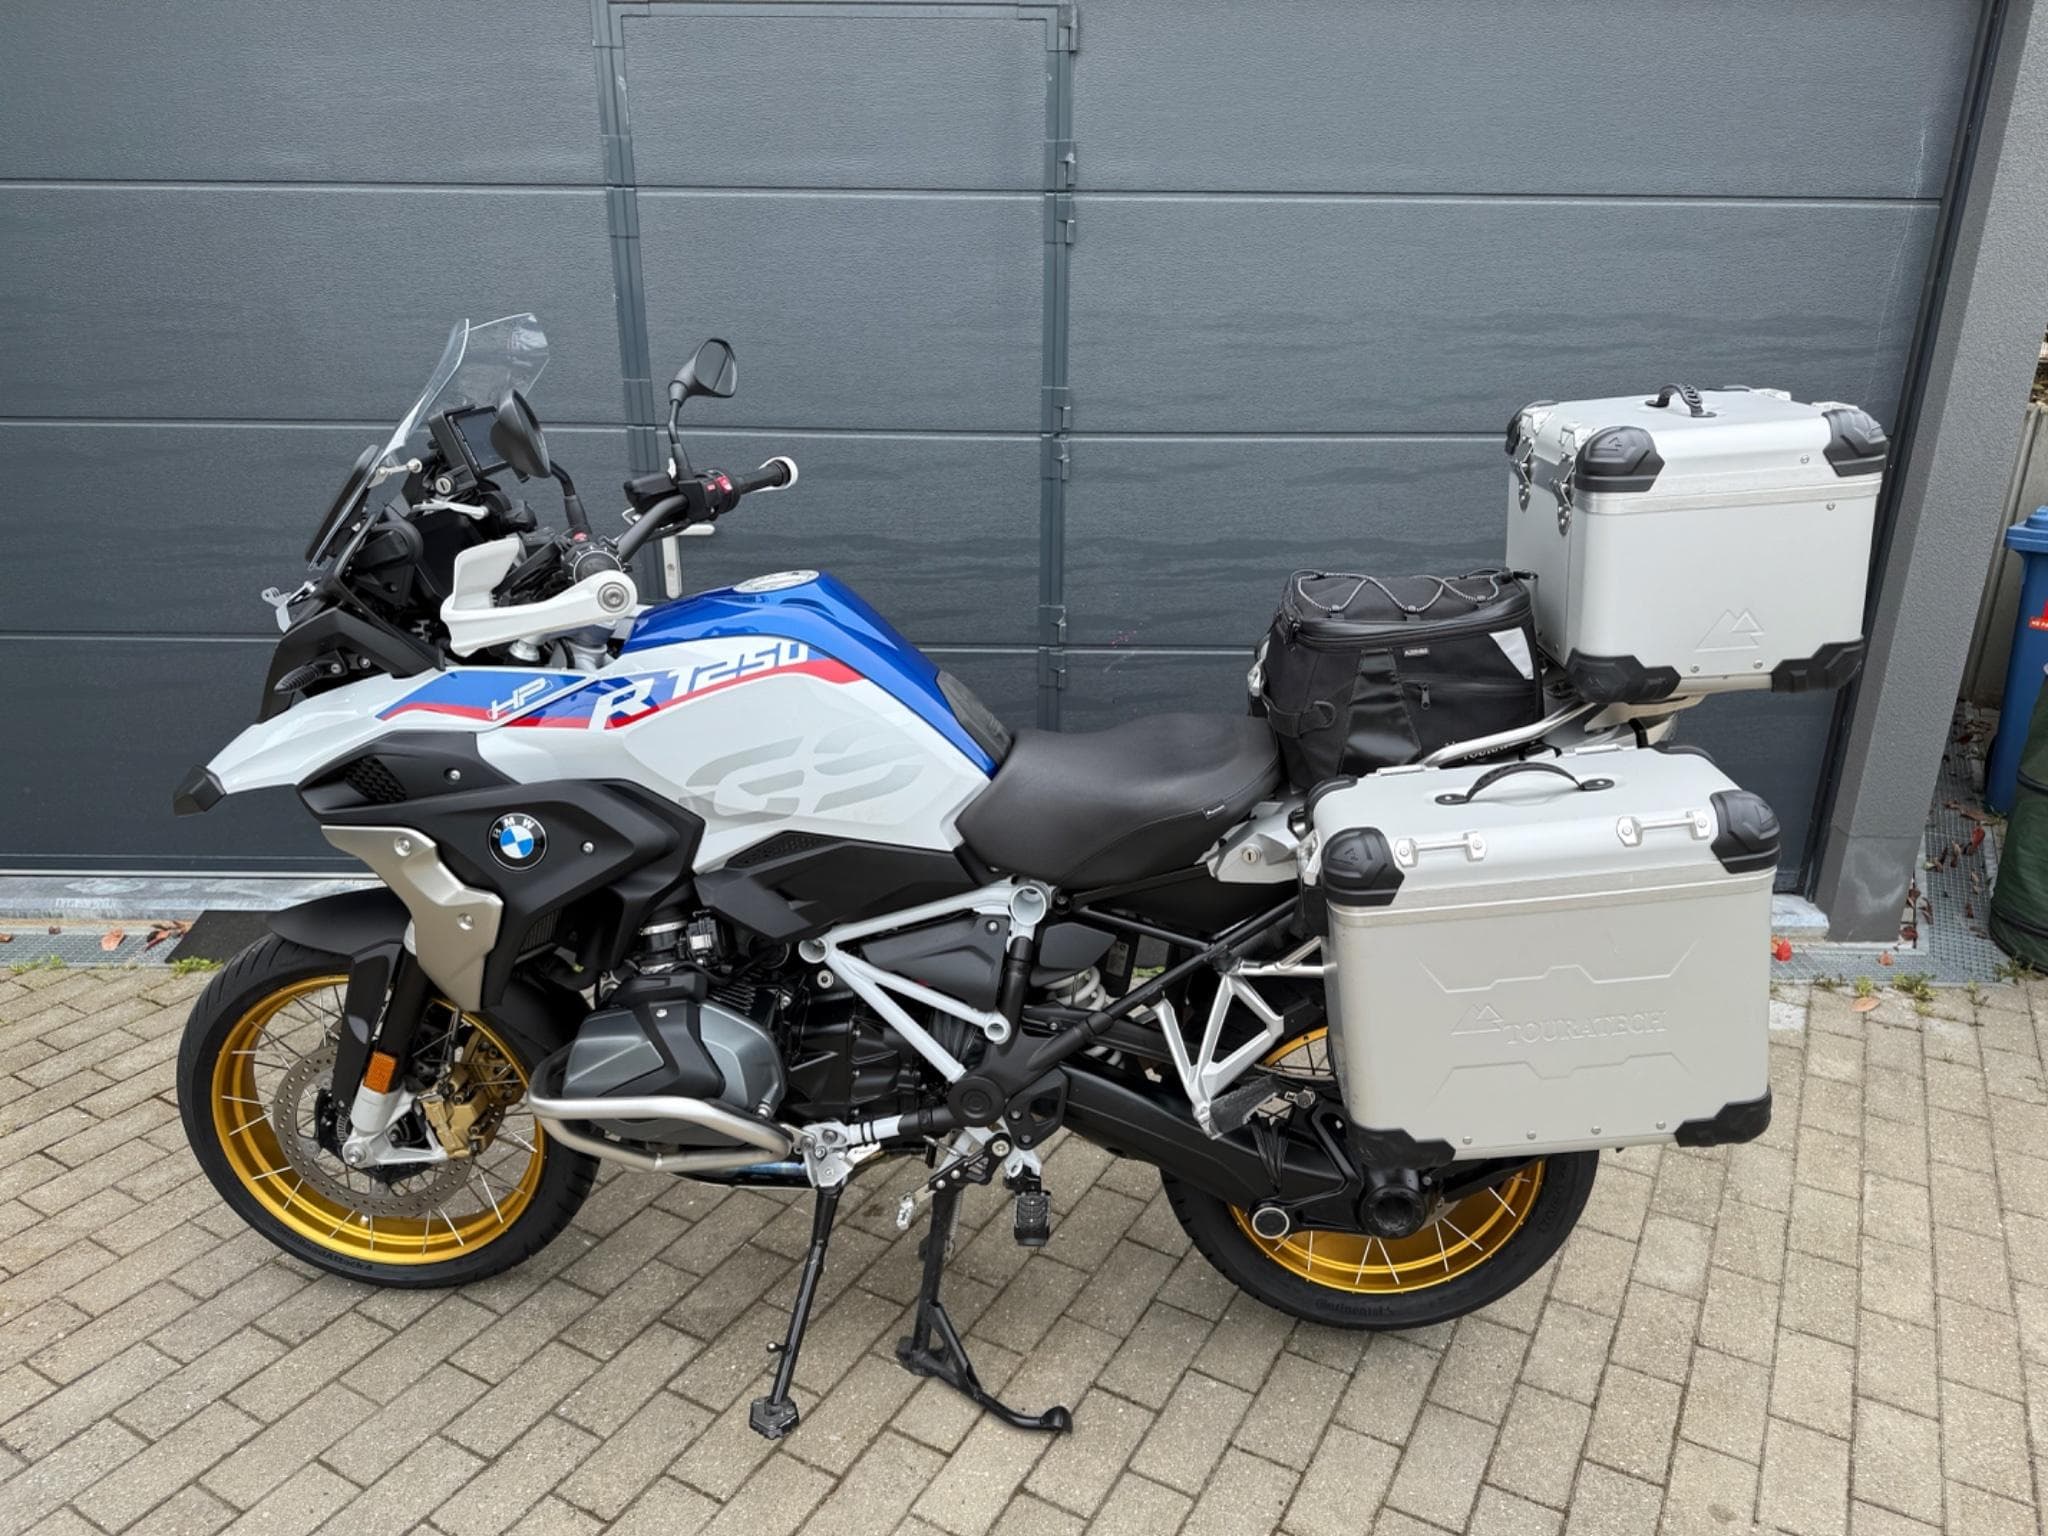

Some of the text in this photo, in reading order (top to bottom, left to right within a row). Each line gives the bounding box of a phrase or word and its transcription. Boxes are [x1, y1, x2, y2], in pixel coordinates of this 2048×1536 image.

[588, 641, 809, 731] R 1250
[492, 816, 535, 839] BMW
[1503, 1011, 1668, 1046] TOURATECH
